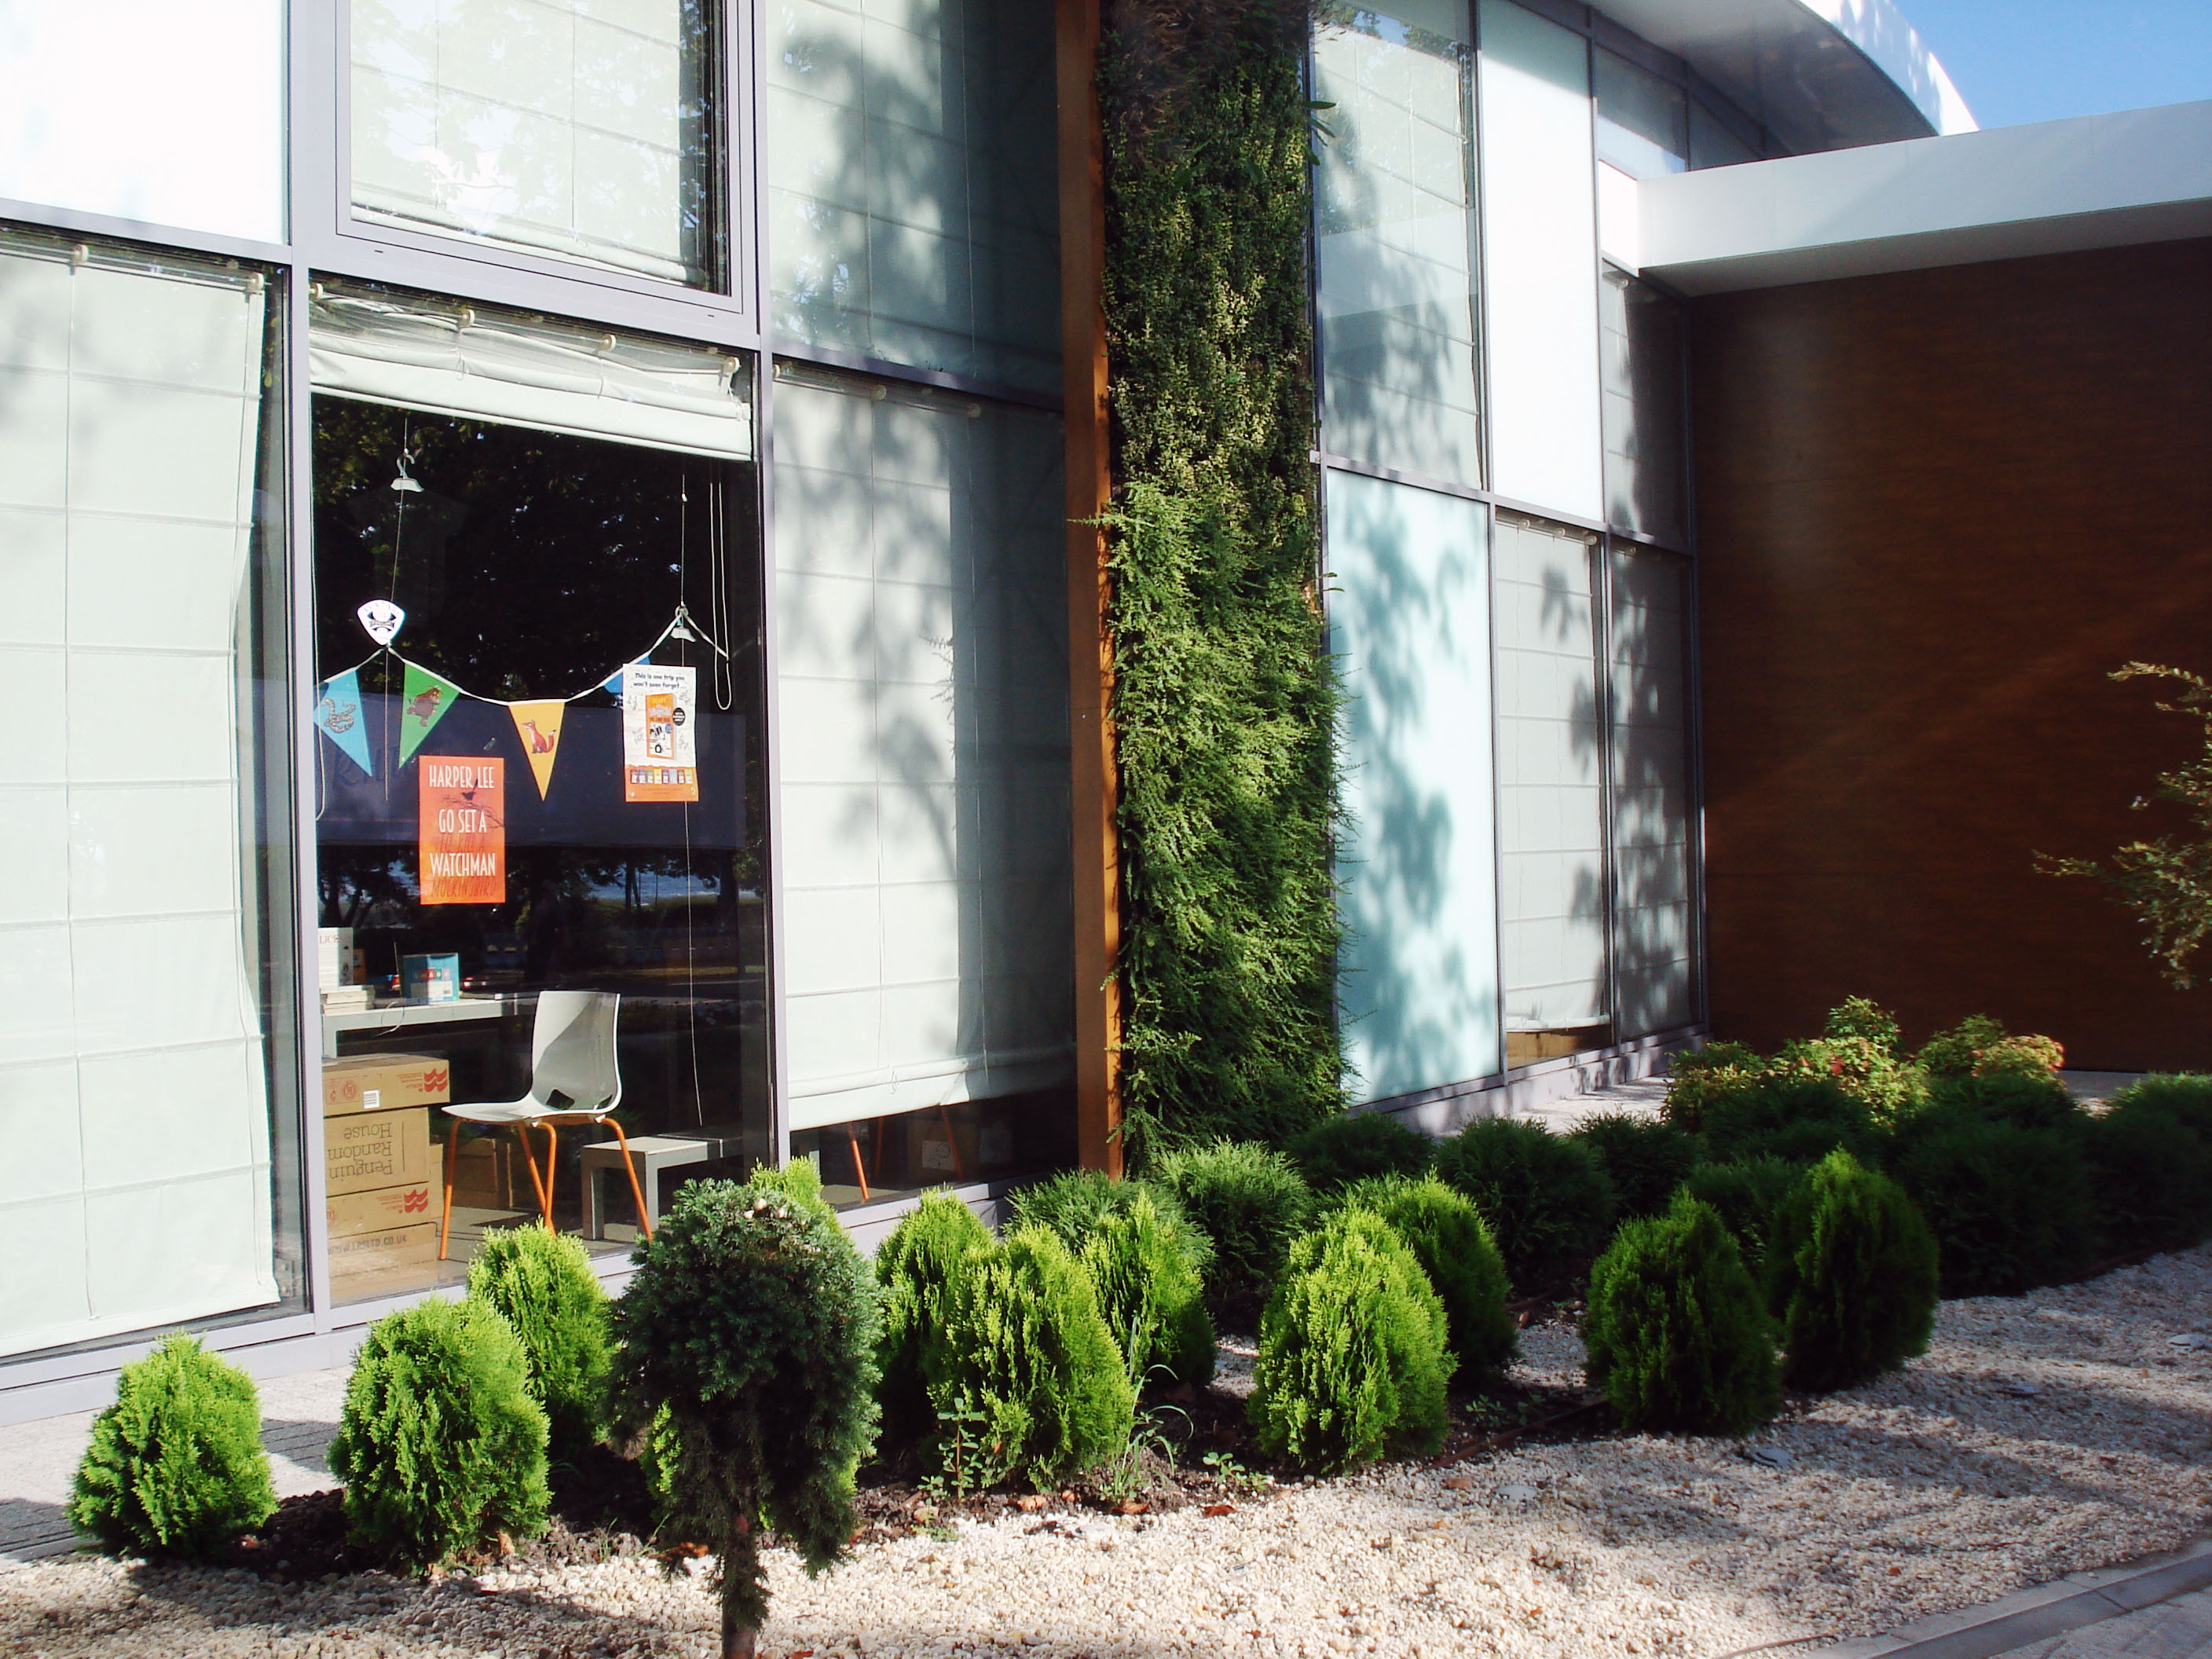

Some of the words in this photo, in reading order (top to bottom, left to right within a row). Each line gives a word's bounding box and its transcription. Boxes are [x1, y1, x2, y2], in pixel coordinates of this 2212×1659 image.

[429, 764, 474, 788] HARPER
[477, 766, 495, 789] LEE
[438, 808, 454, 833] GO
[458, 808, 477, 833] SET
[478, 810, 487, 833] A
[428, 852, 496, 877] WATCHMAN
[344, 1122, 393, 1139] House
[327, 1141, 393, 1161] Random
[329, 1159, 394, 1181] Penguin
